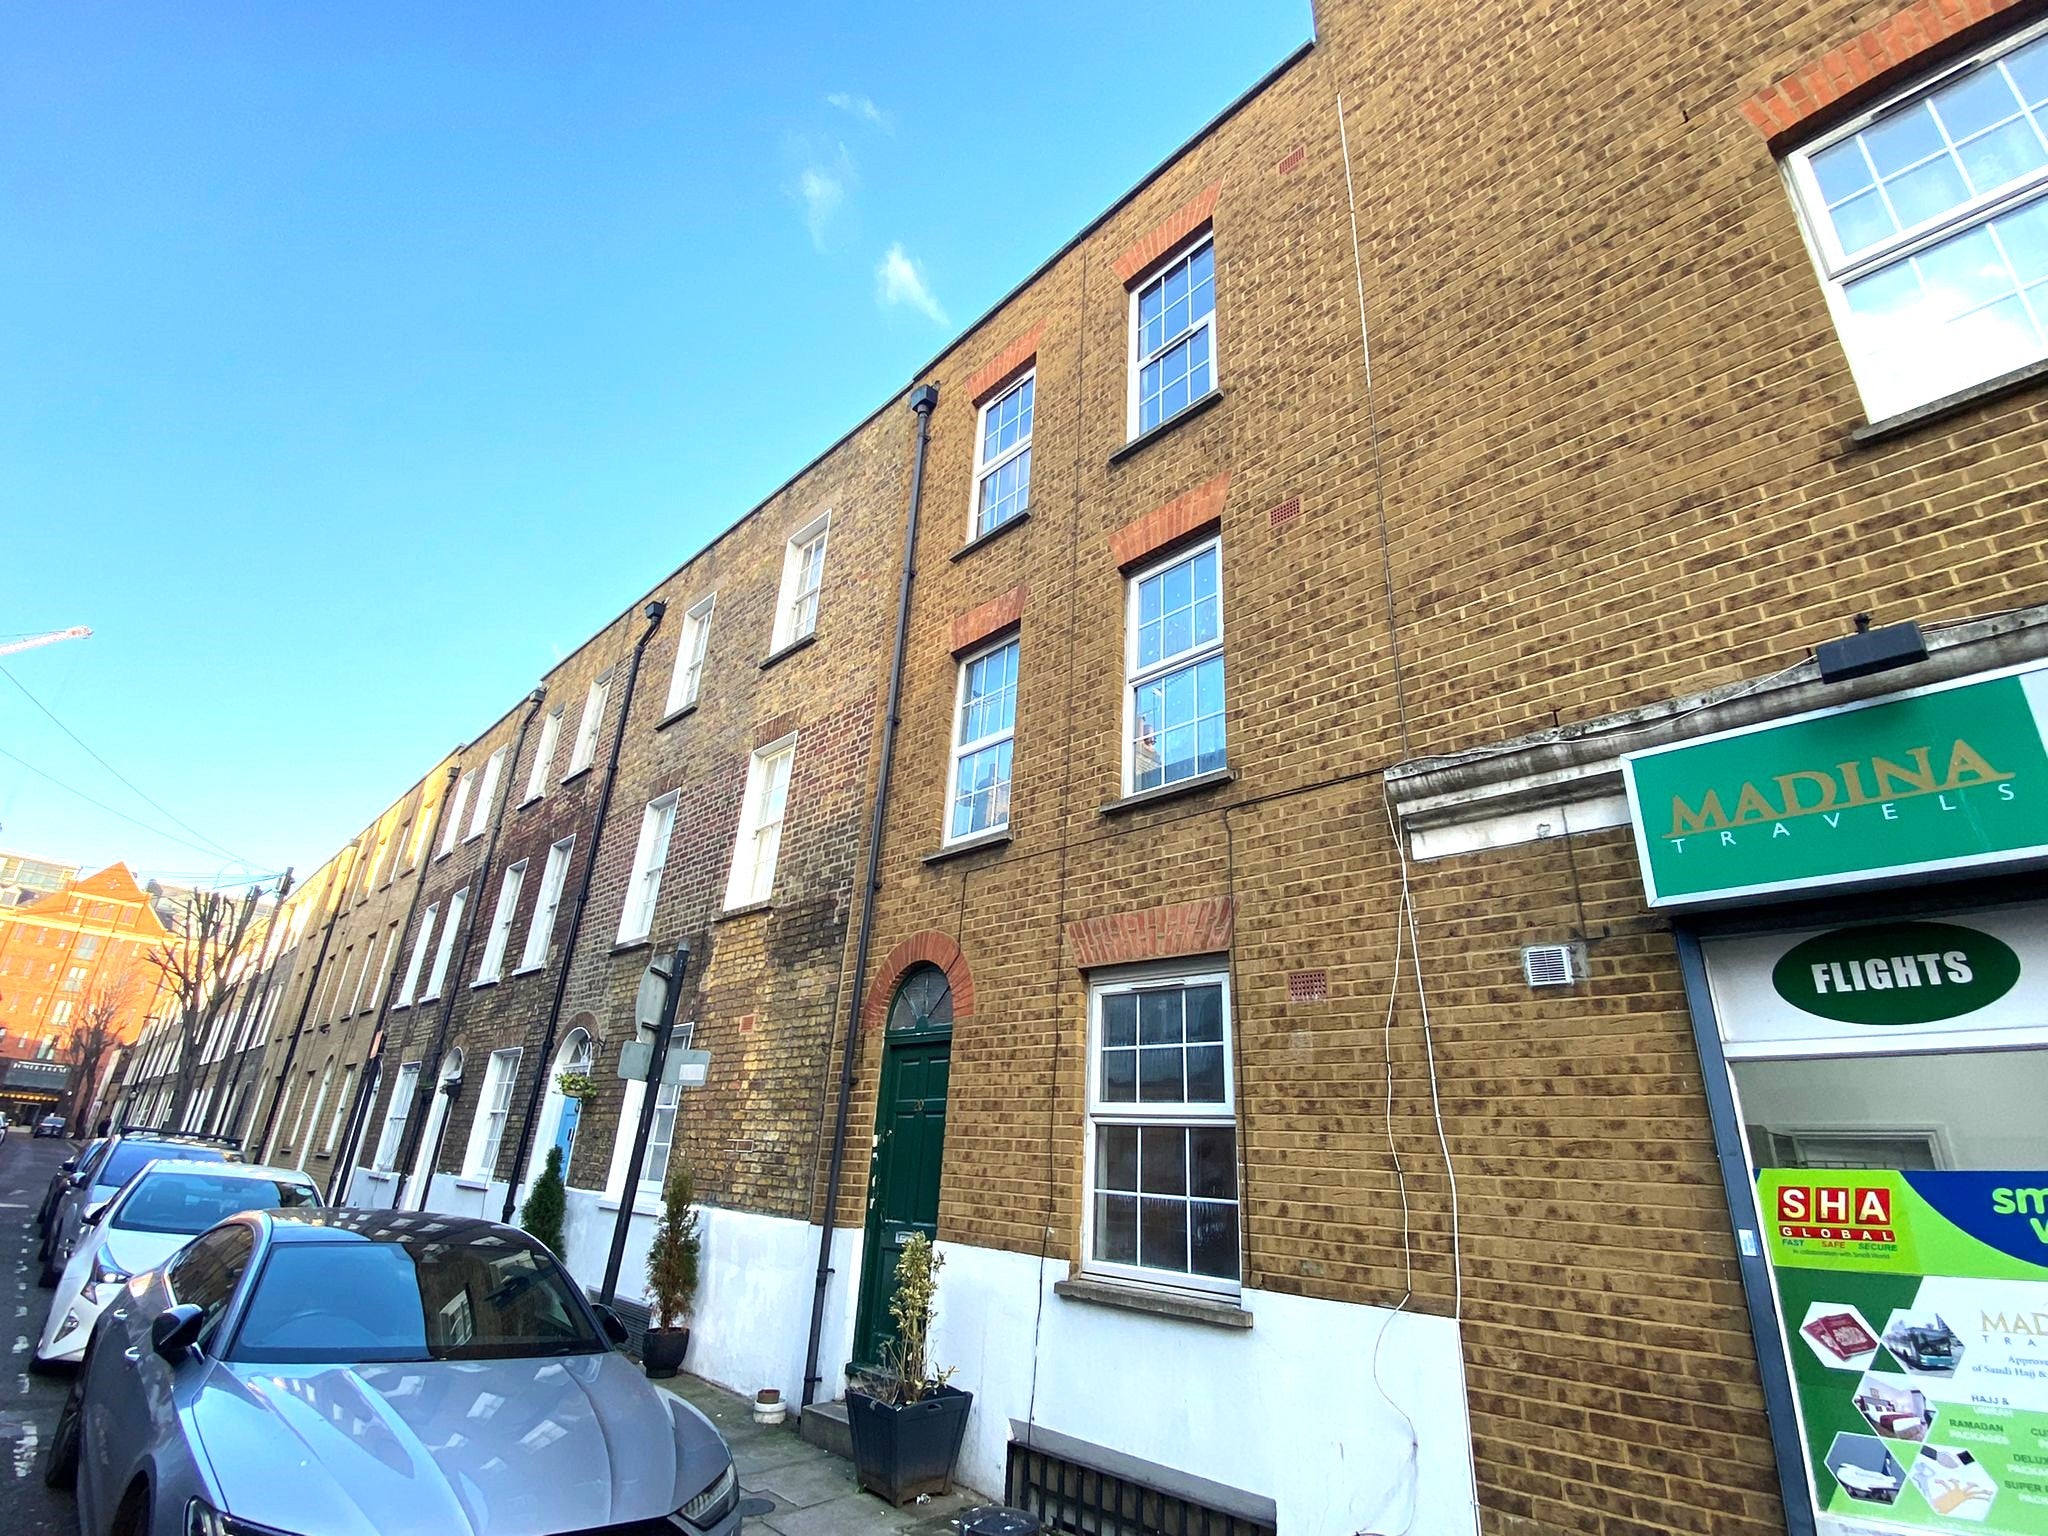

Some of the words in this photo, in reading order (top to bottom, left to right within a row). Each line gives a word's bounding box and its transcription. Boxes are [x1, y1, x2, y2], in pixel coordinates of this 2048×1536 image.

[1662, 739, 2016, 839] MADINA
[1671, 783, 2015, 853] TRAVELS
[1811, 950, 1974, 994] FLIGHTS
[1782, 1188, 1888, 1222] SHA
[1782, 1226, 1893, 1241] GLOBAL
[1782, 1239, 1804, 1247] FAST
[1821, 1240, 1846, 1249] SAFE
[1857, 1242, 1898, 1252] SECURE
[1971, 1395, 2000, 1405] HAJJ
[2001, 1397, 2010, 1406] &
[1949, 1419, 2005, 1433] RAMADAN
[2004, 1480, 2042, 1493] SUPER
